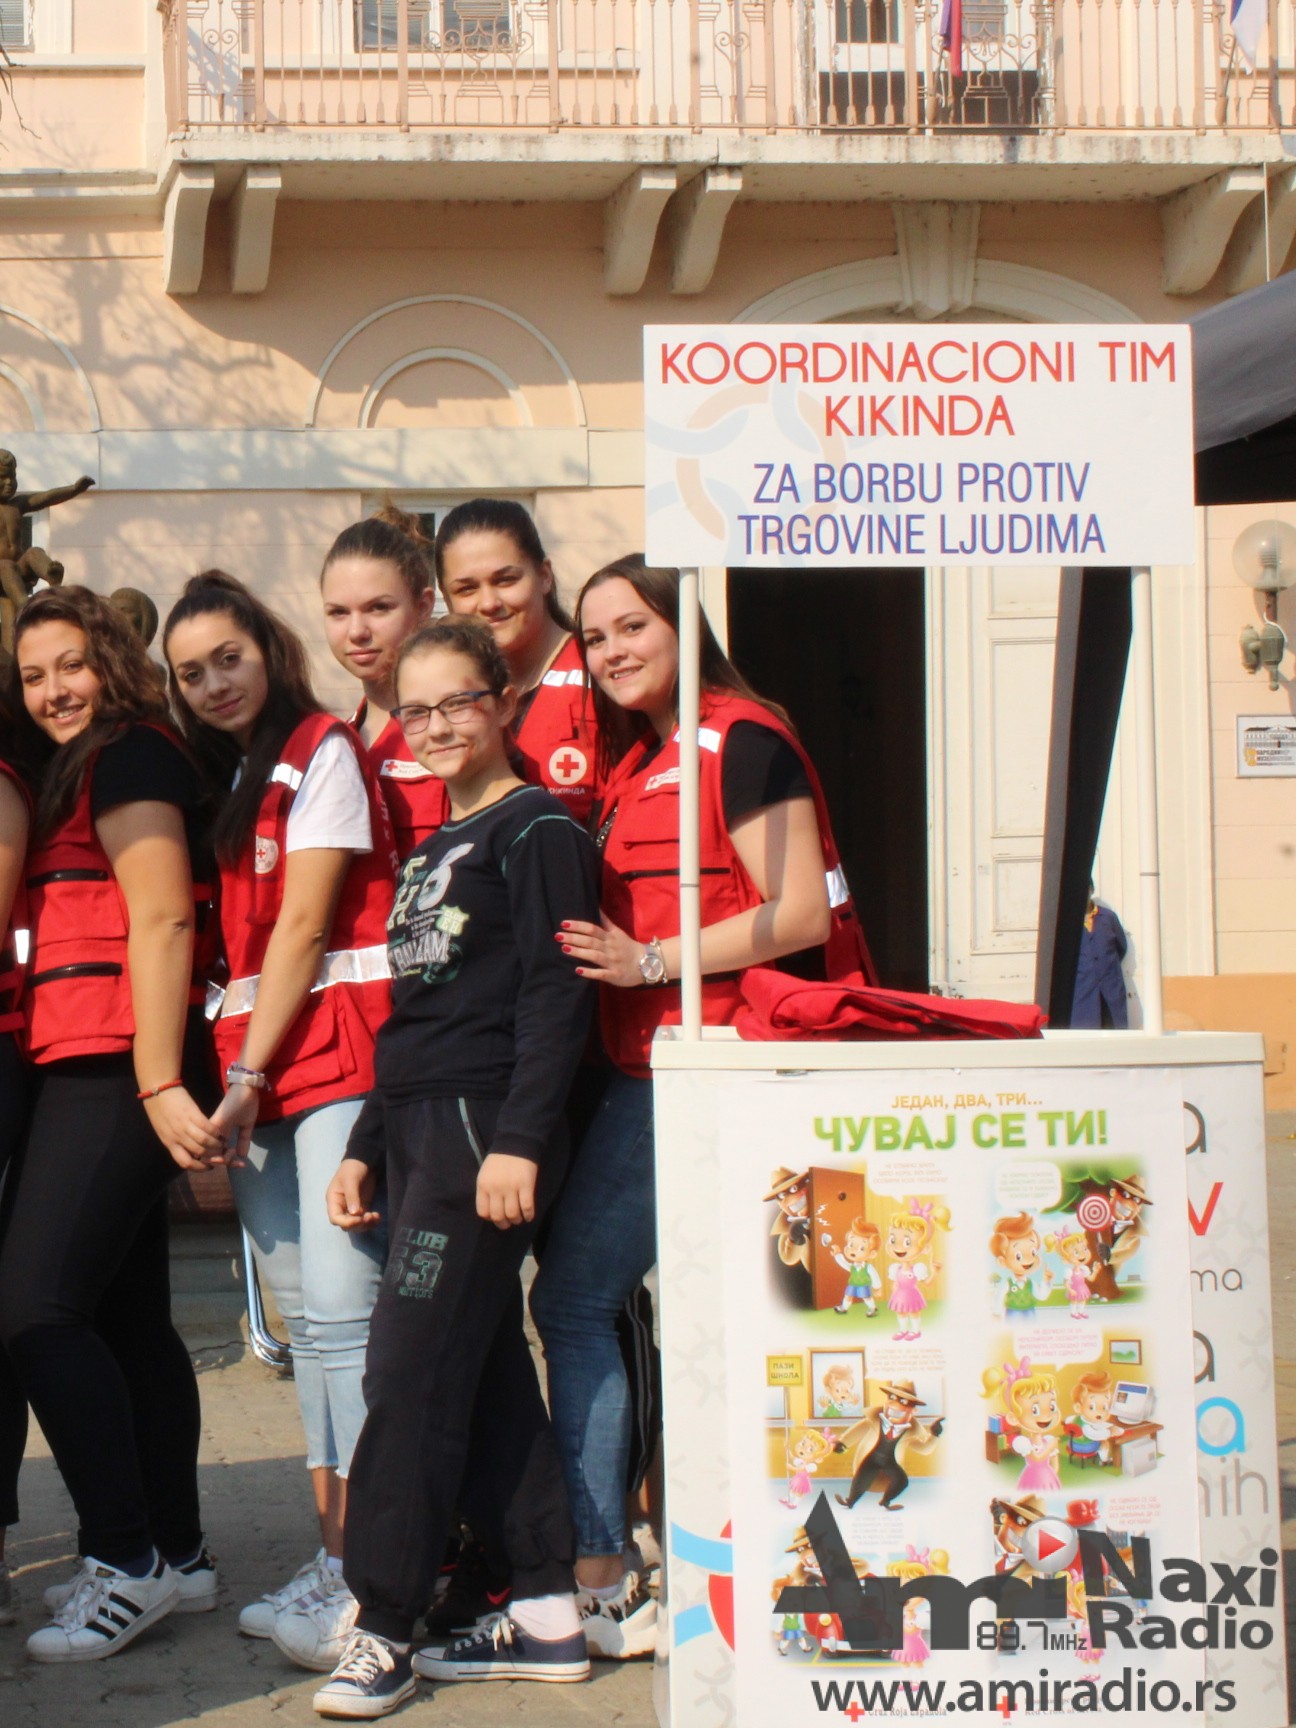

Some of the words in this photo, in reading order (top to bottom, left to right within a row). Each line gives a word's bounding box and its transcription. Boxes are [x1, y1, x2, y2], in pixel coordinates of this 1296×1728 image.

[661, 340, 1076, 384] KOORDINACIONI
[1099, 340, 1176, 383] TIM
[824, 394, 1016, 437] KIKINDA
[753, 462, 801, 504] ZA
[813, 462, 943, 503] BORBU
[957, 461, 1091, 503] PROTIV
[737, 513, 925, 555] TRGOVINE
[939, 513, 1106, 554] LJUDIMA
[892, 1096, 949, 1110] ЈЕДАН,
[953, 1094, 992, 1109] ДВА,
[996, 1093, 1043, 1106] ТРИ...
[813, 1115, 957, 1152] ЧУВАЈ
[972, 1113, 1027, 1148] СЕ
[1037, 1109, 1109, 1146] ТИ!
